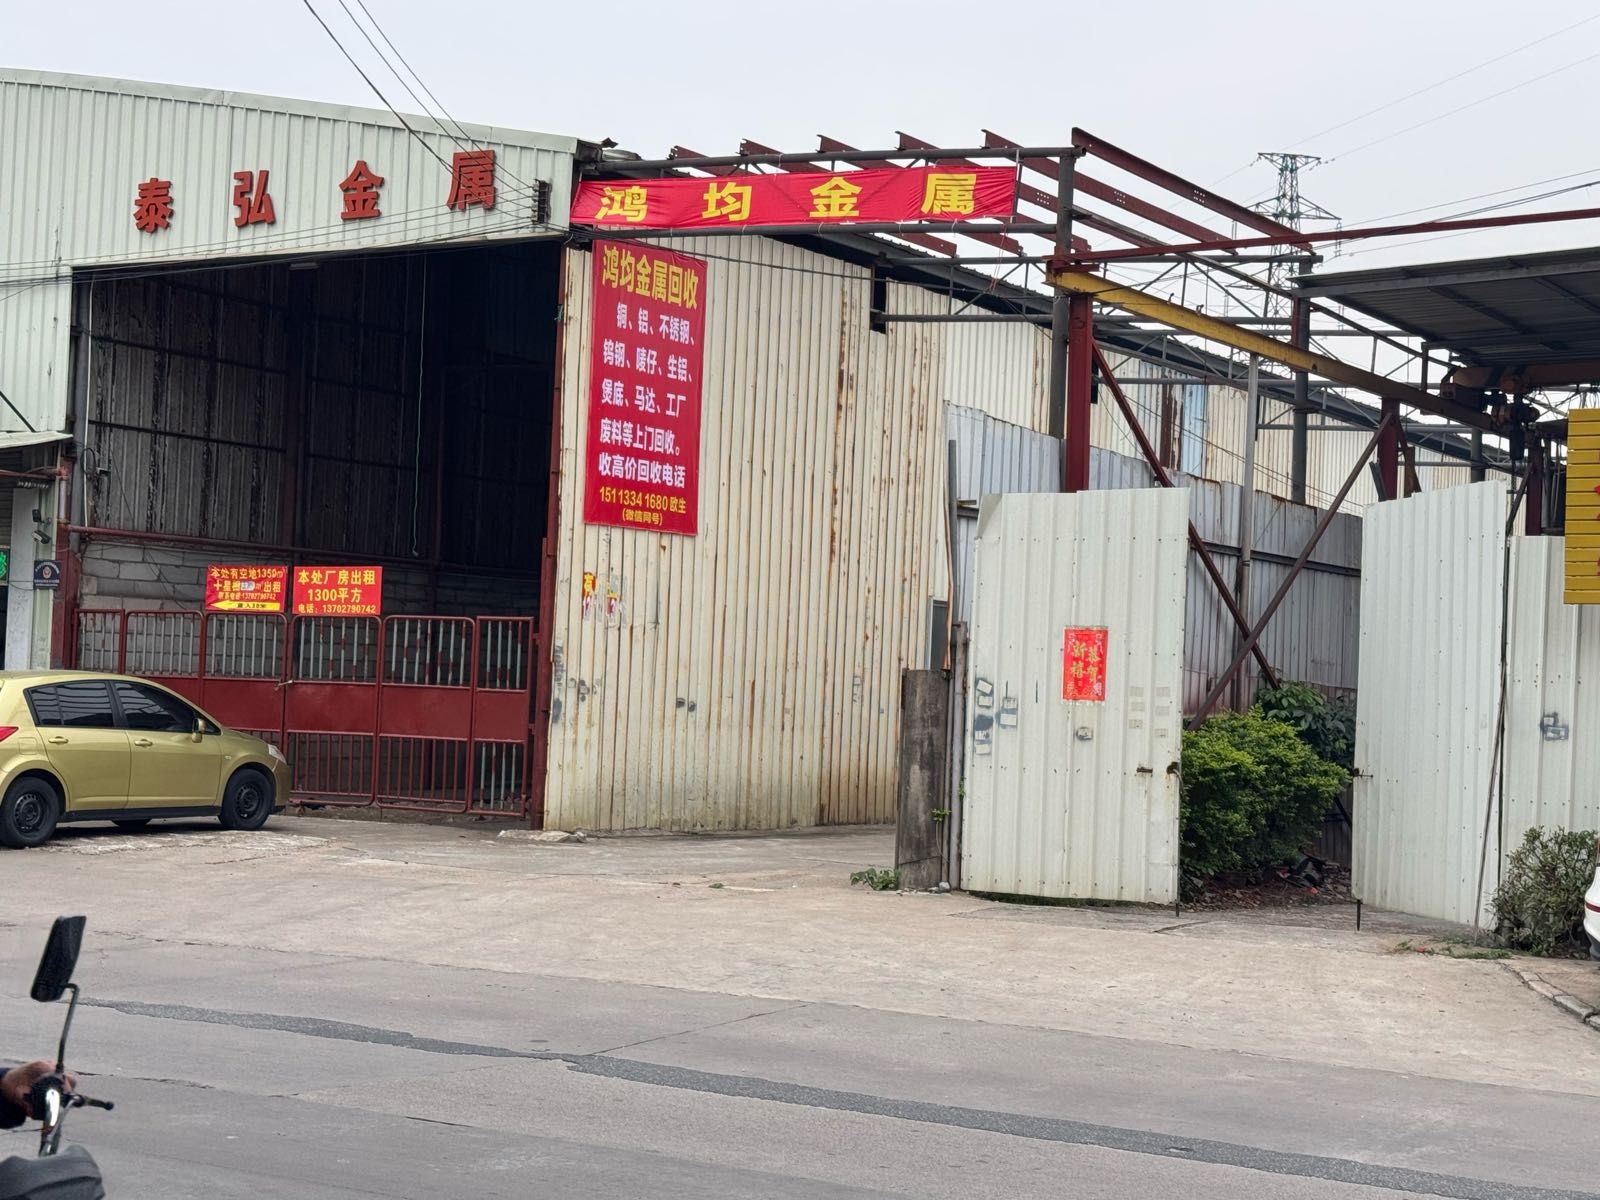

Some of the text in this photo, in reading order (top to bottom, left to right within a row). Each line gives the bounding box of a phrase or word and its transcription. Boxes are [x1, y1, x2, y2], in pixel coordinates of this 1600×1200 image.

[134, 149, 497, 233] 泰弘金属
[595, 172, 978, 223] 鸿均金属
[602, 244, 699, 310] 鸿均金属回收
[599, 417, 681, 457] 废料等上门回收。
[598, 452, 686, 489] 收高价回收电话
[298, 569, 376, 585] 本处厂房出租
[307, 587, 362, 603] 1300平方
